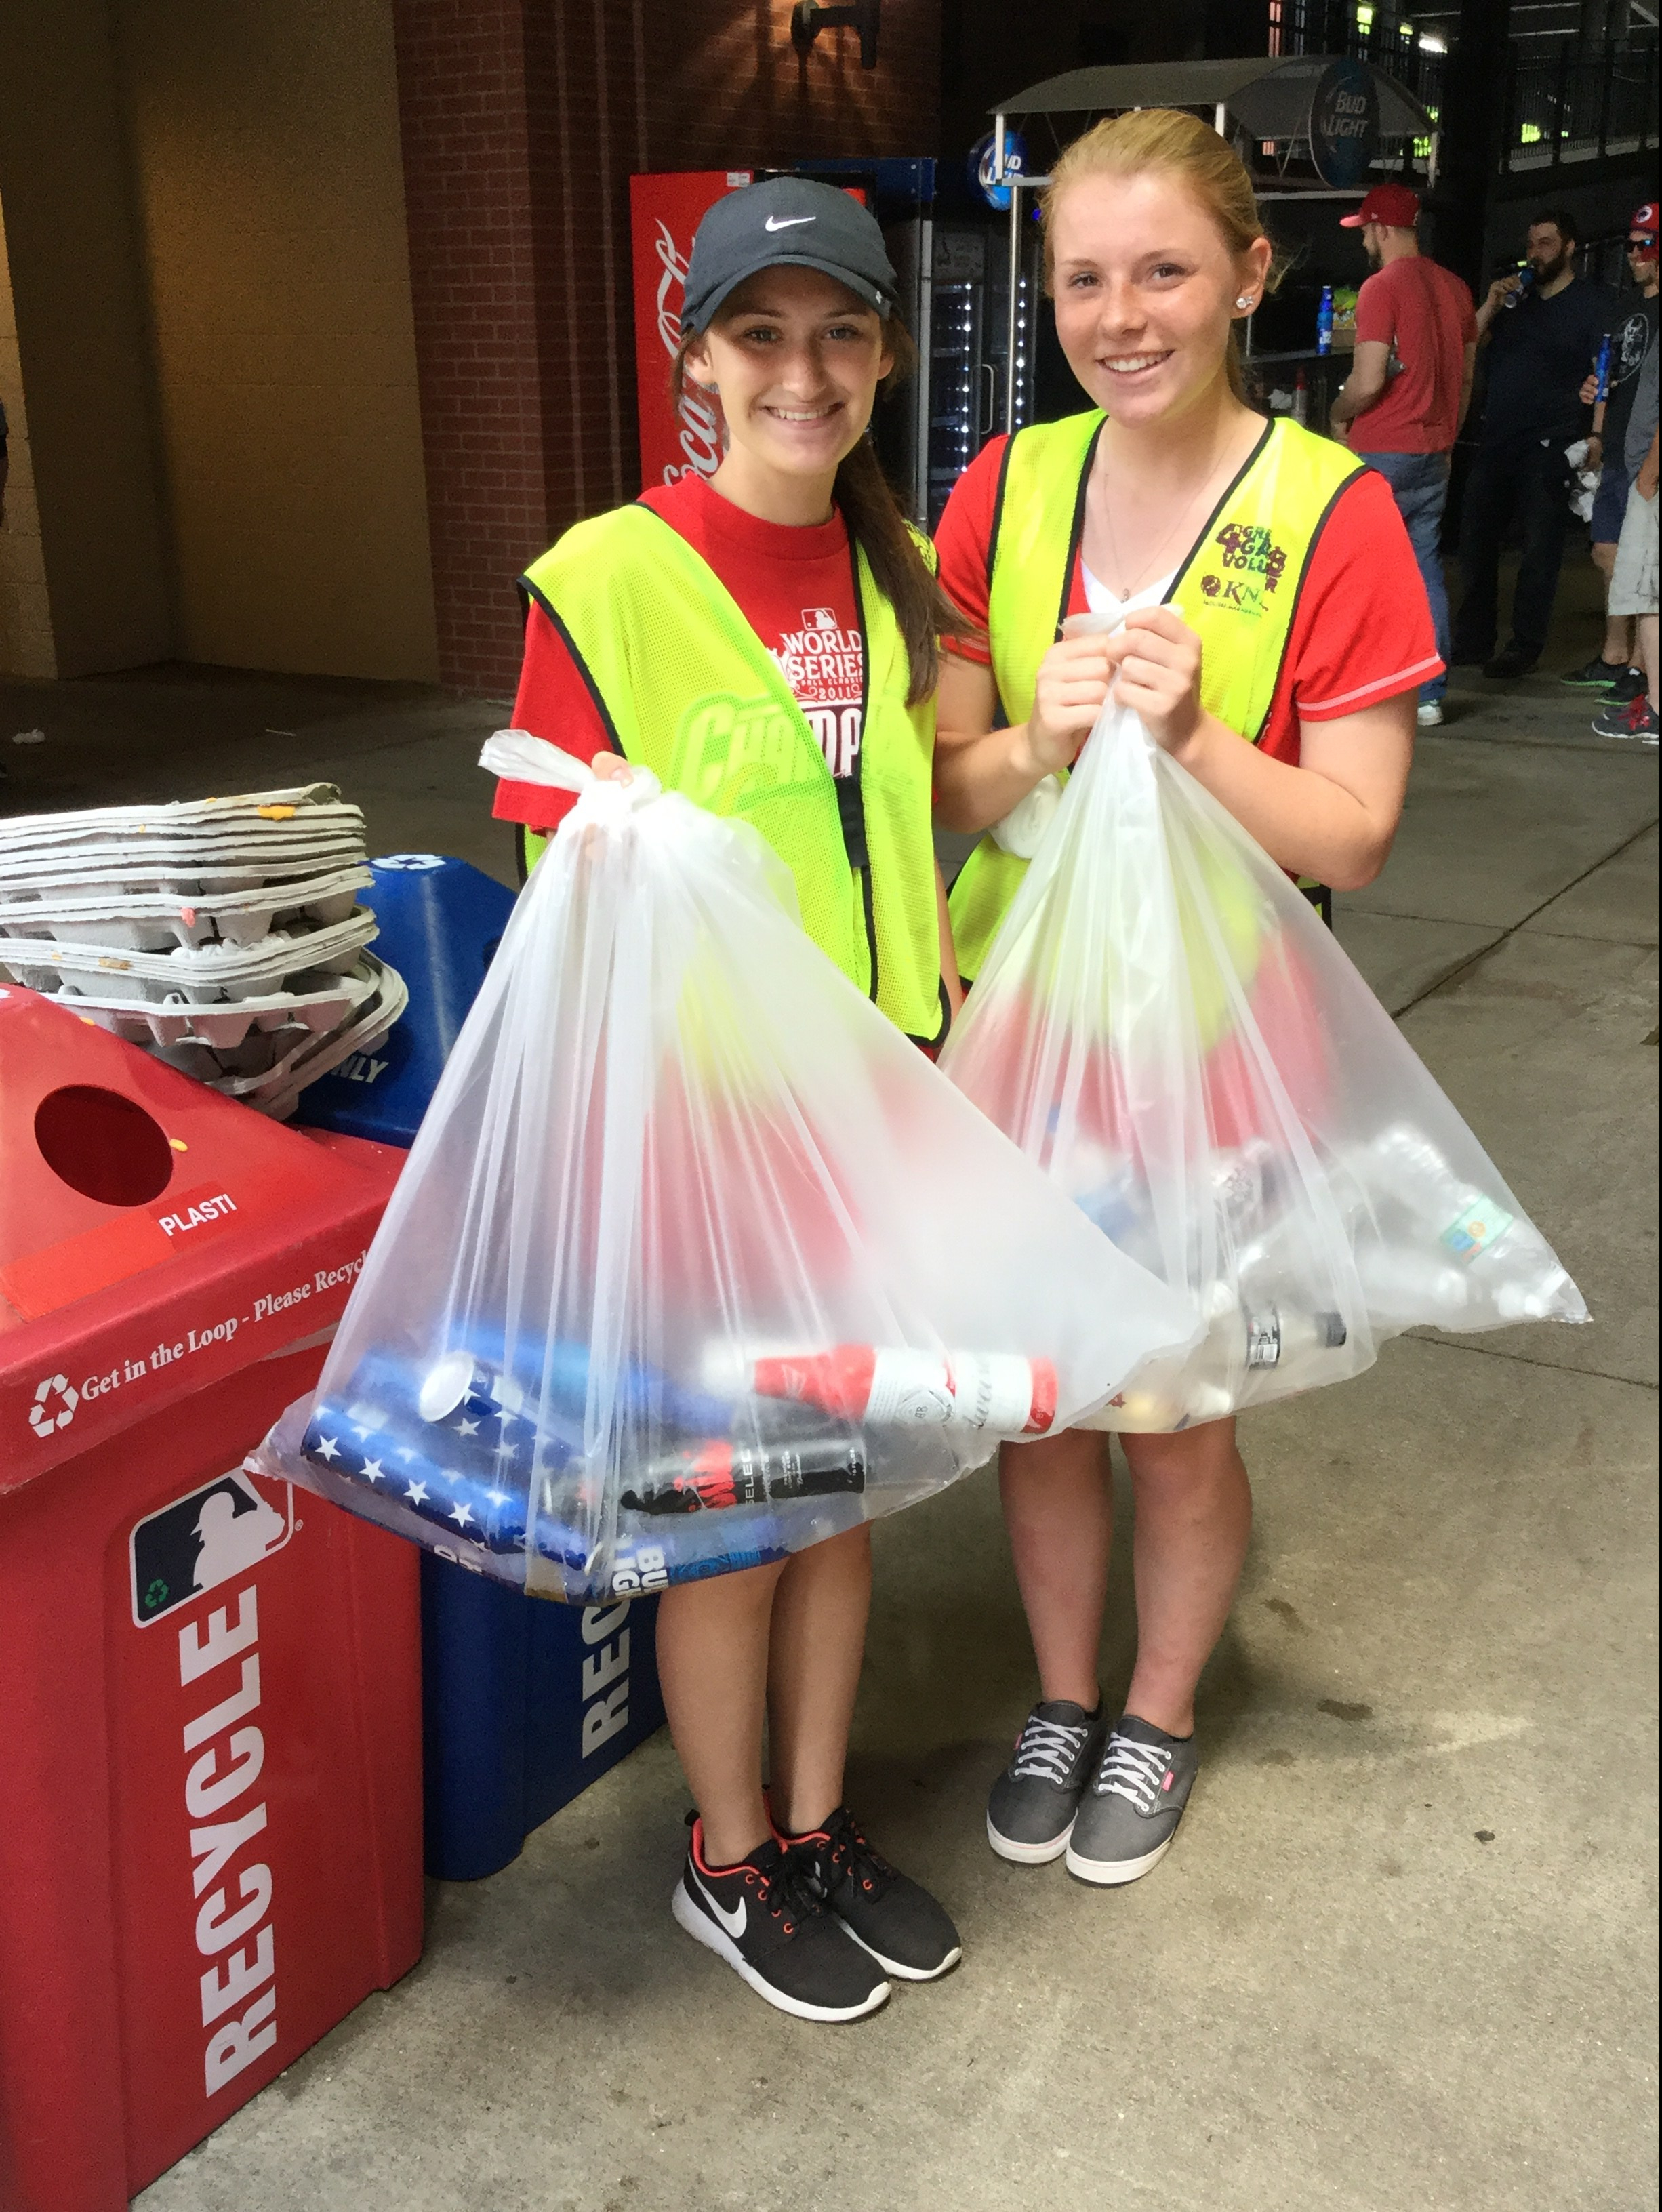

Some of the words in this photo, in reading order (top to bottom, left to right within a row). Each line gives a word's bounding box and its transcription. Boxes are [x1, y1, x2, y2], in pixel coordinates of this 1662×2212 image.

[1335, 90, 1366, 115] BUD
[1326, 114, 1369, 138] LIGHT
[779, 629, 862, 655] WORLD
[819, 686, 851, 699] 2011
[330, 1054, 389, 1083] NLY
[158, 1194, 237, 1237] PLASTI
[81, 1368, 120, 1401] Get
[124, 1359, 147, 1383] in
[150, 1343, 184, 1370] the
[187, 1317, 238, 1353] Loop
[253, 1283, 311, 1322] Please
[740, 1448, 755, 1504] SELEC
[178, 1584, 277, 2099] RECYCLE
